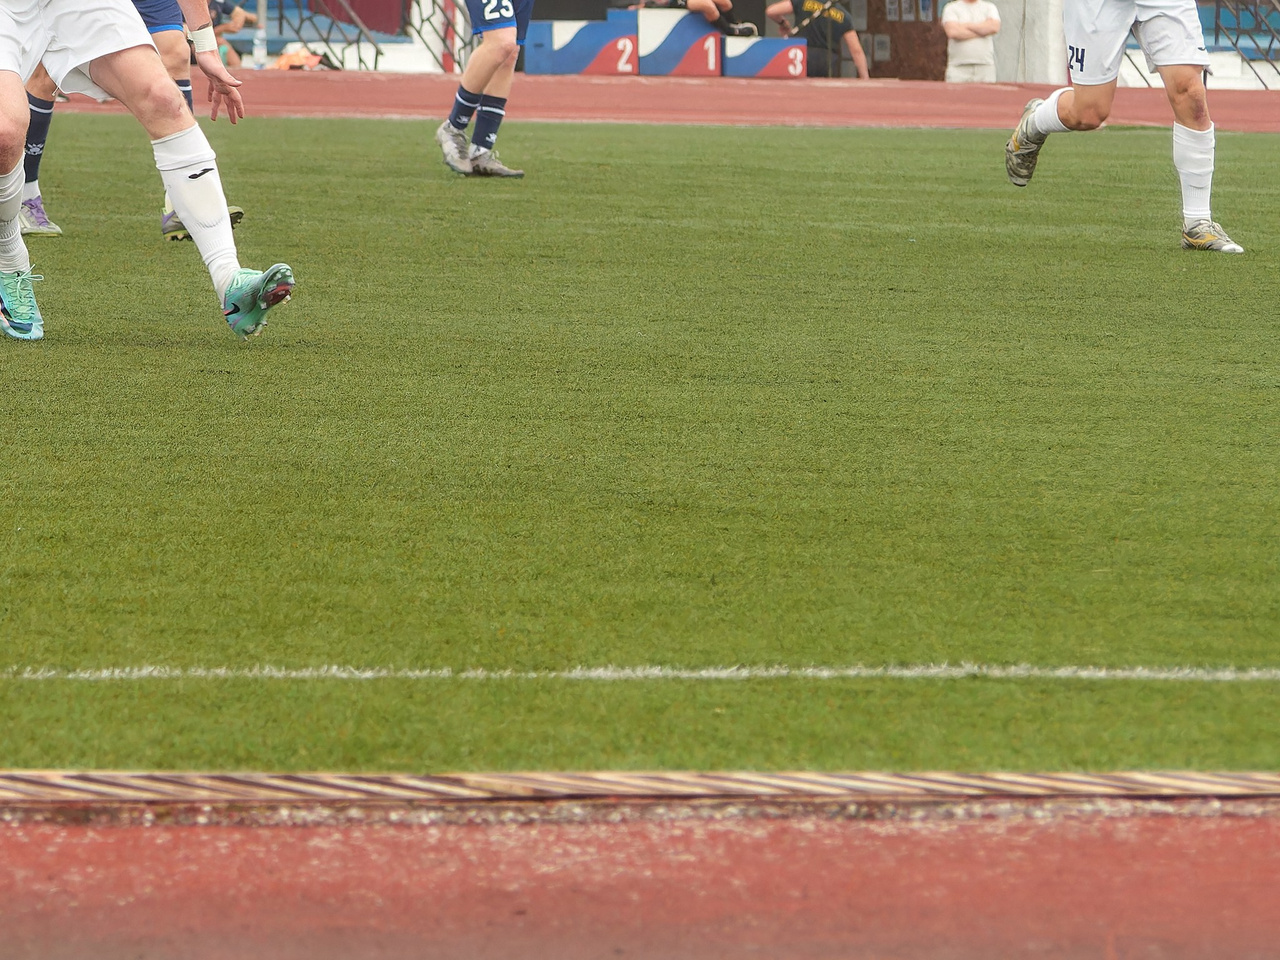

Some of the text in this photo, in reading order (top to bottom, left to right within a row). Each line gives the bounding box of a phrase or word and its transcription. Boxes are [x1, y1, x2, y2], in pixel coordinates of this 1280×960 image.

[617, 38, 634, 72] 2
[704, 36, 716, 71] 1
[788, 48, 804, 76] 3
[1068, 45, 1085, 72] 24
